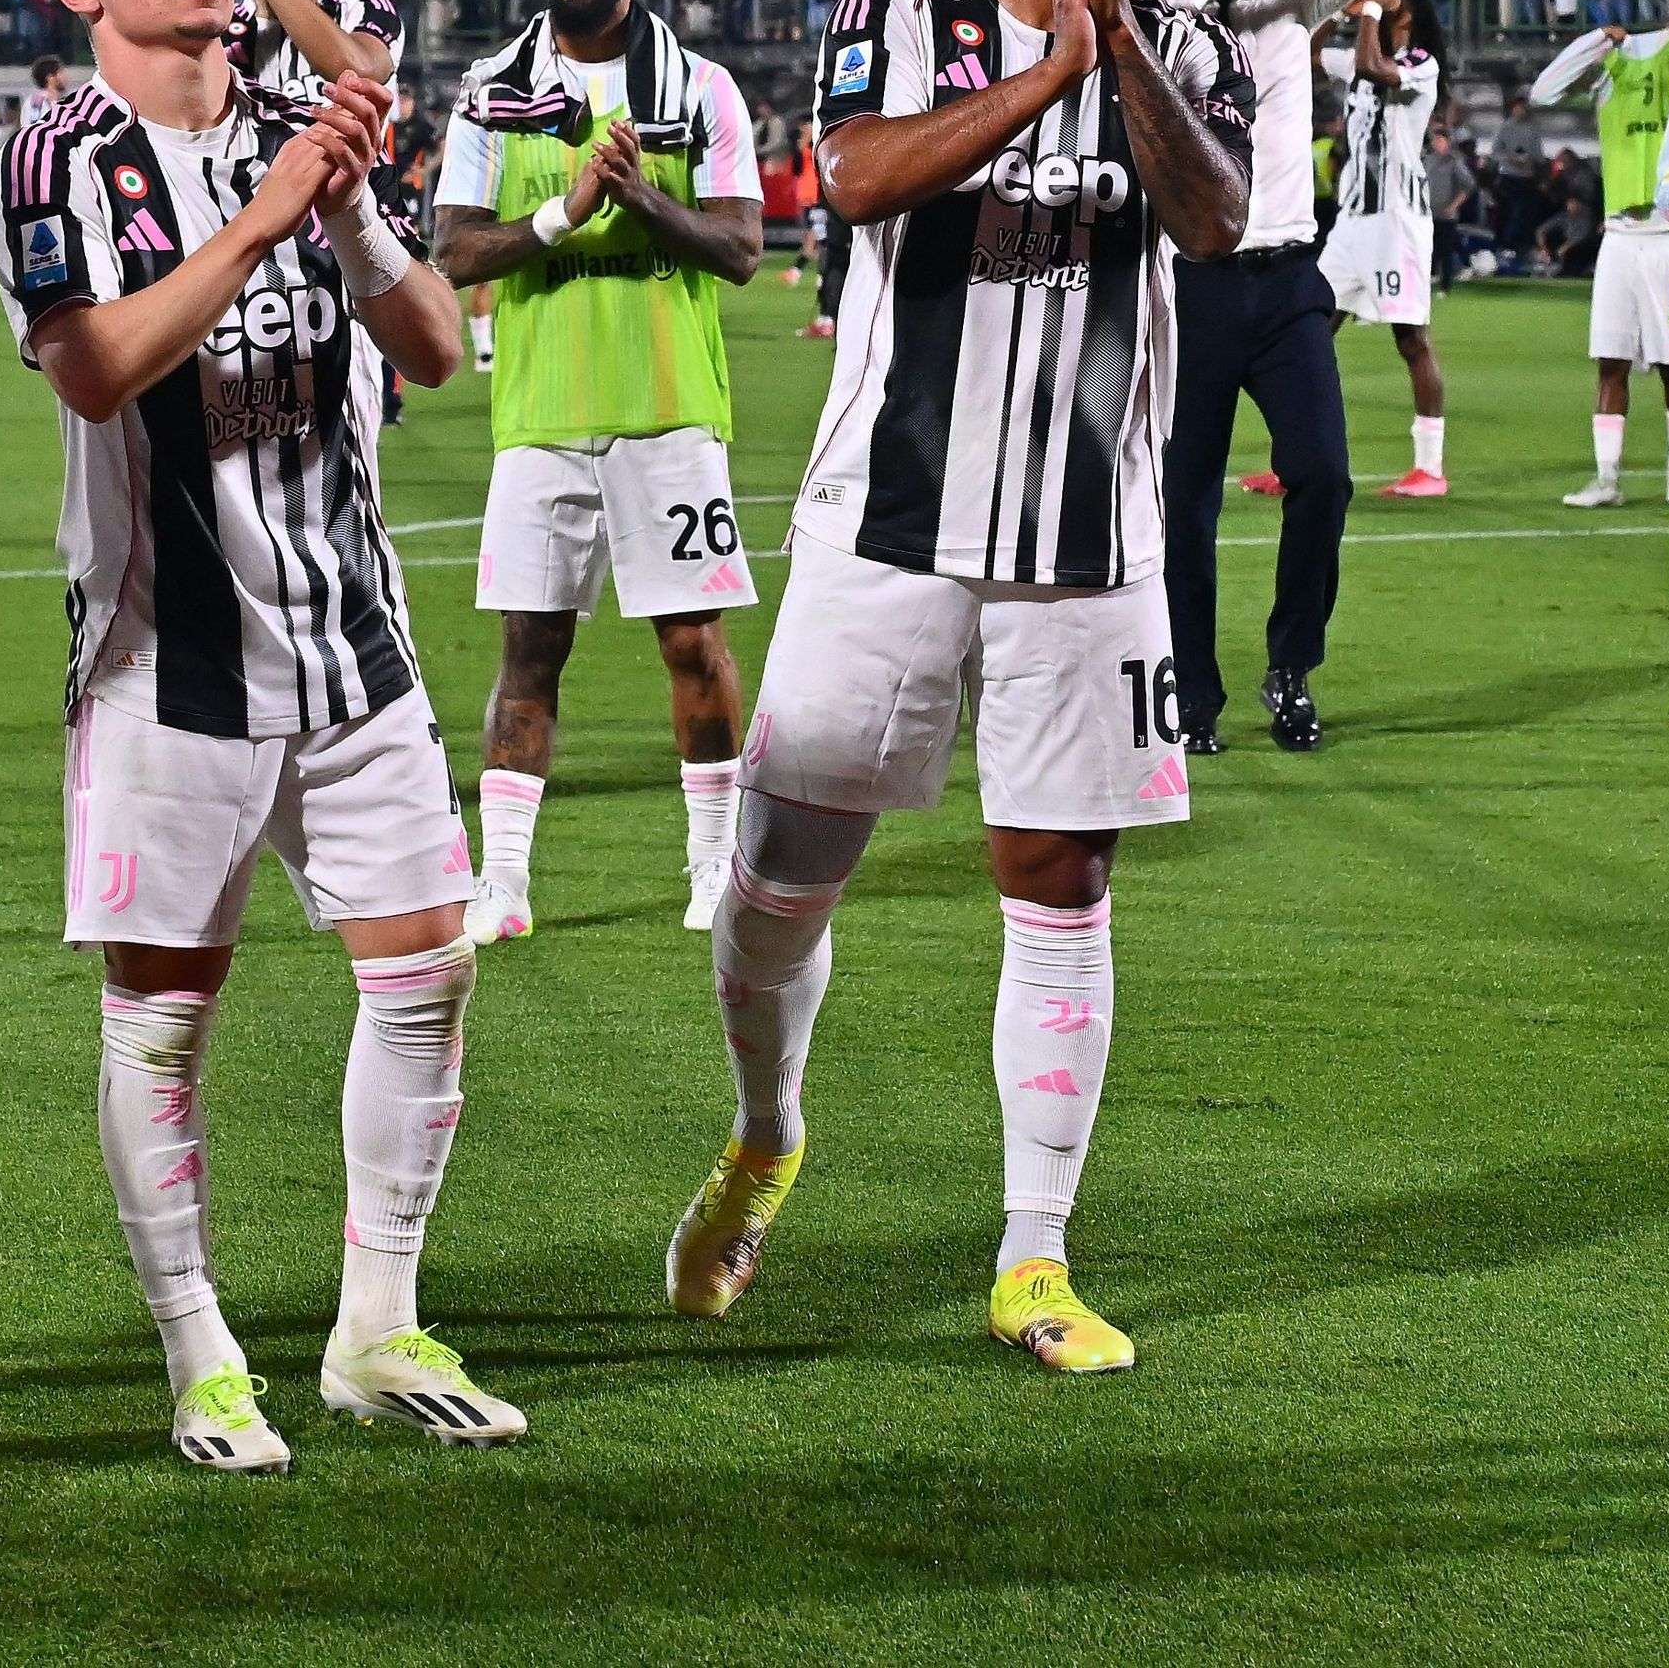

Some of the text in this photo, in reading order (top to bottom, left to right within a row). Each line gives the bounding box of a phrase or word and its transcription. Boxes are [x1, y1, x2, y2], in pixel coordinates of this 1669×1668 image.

[953, 150, 1129, 224] eep
[998, 228, 1062, 257] VISIT
[546, 250, 638, 285] Allianz
[968, 246, 1090, 291] Detroit
[1374, 270, 1401, 298] 19
[203, 285, 337, 362] eep
[221, 378, 292, 407] VISIT
[204, 400, 317, 449] Detroit
[666, 497, 739, 561] 26
[1120, 655, 1182, 749] 16
